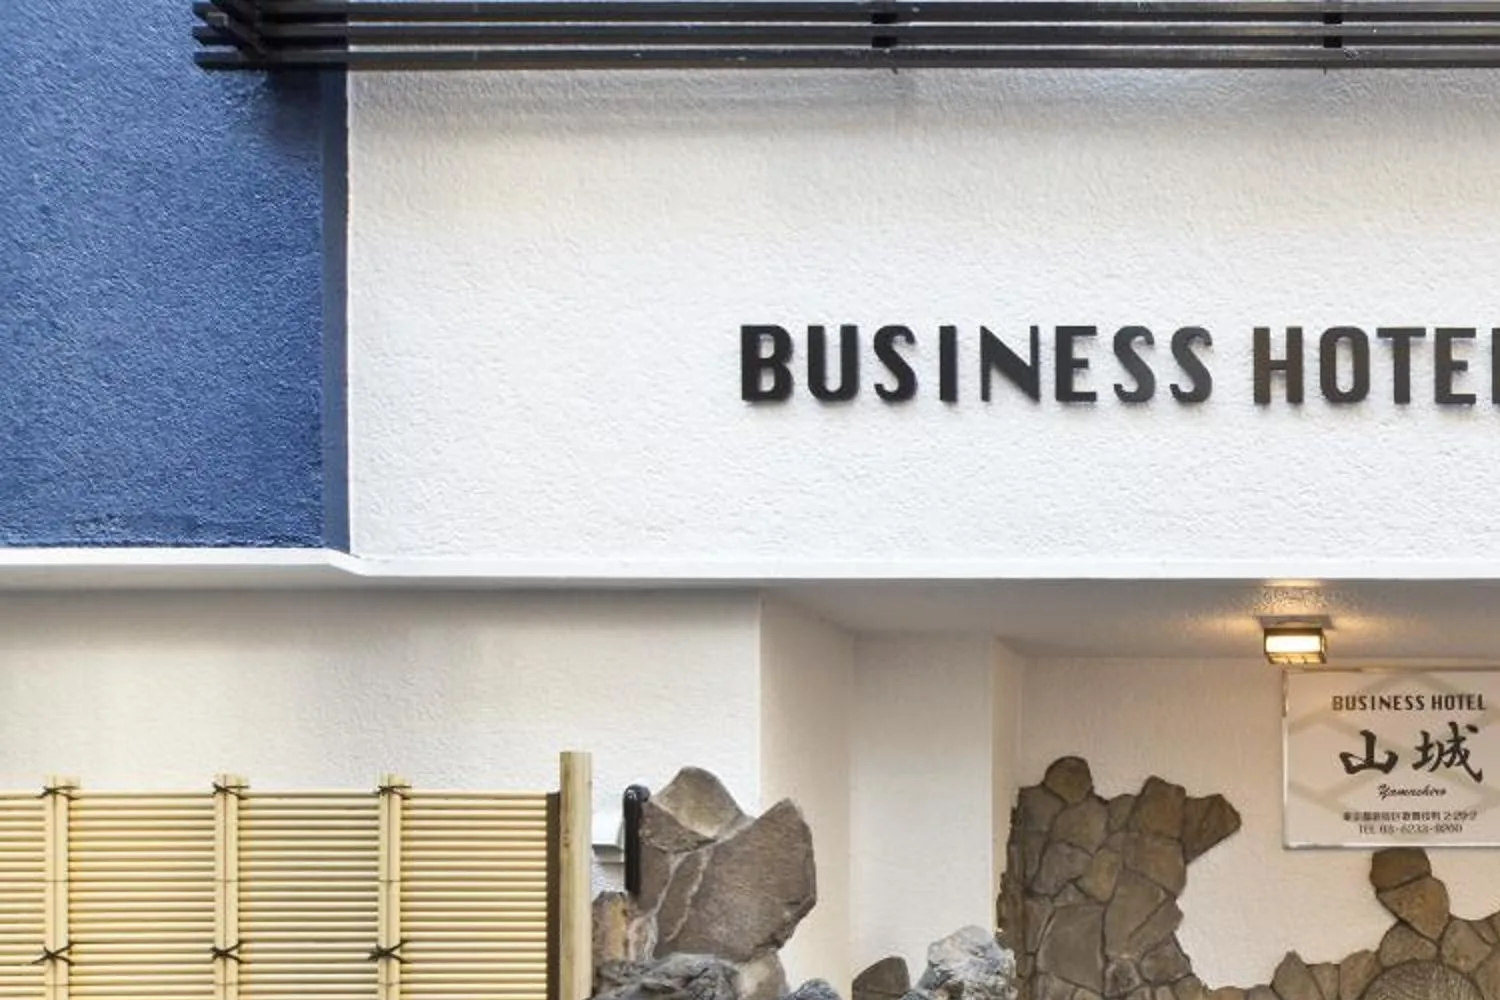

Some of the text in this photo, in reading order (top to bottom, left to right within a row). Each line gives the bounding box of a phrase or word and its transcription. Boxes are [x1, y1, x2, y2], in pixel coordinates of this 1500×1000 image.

[740, 324, 1213, 406] BUSINESS
[1332, 693, 1487, 711] BUSINESS HOTEL
[1339, 721, 1483, 783] 山城
[1378, 784, 1447, 800] Yamashiro
